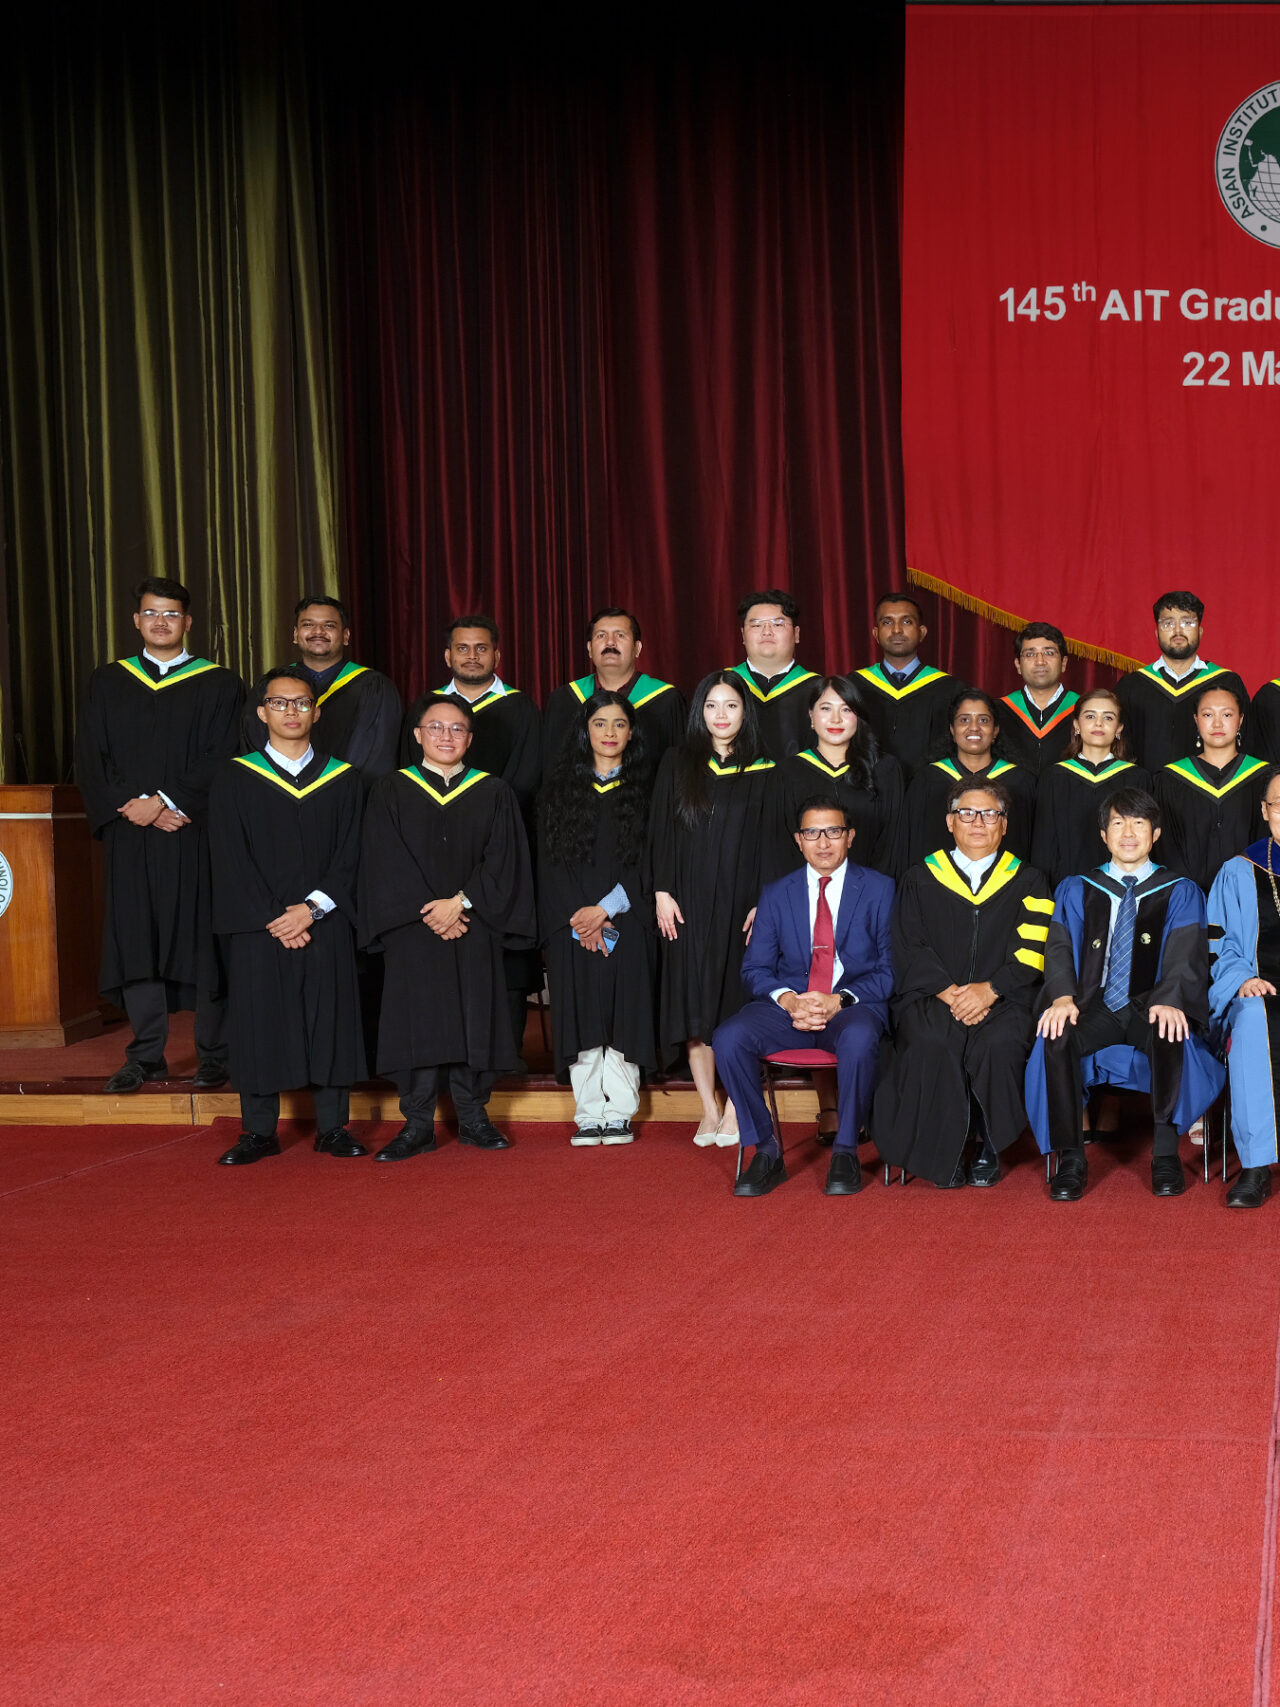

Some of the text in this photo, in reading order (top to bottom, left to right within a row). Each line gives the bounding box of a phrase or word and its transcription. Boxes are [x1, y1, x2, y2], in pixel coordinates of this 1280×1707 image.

[1222, 167, 1255, 220] ASIAN
[1099, 288, 1170, 322] AIT
[1182, 350, 1231, 387] 22
